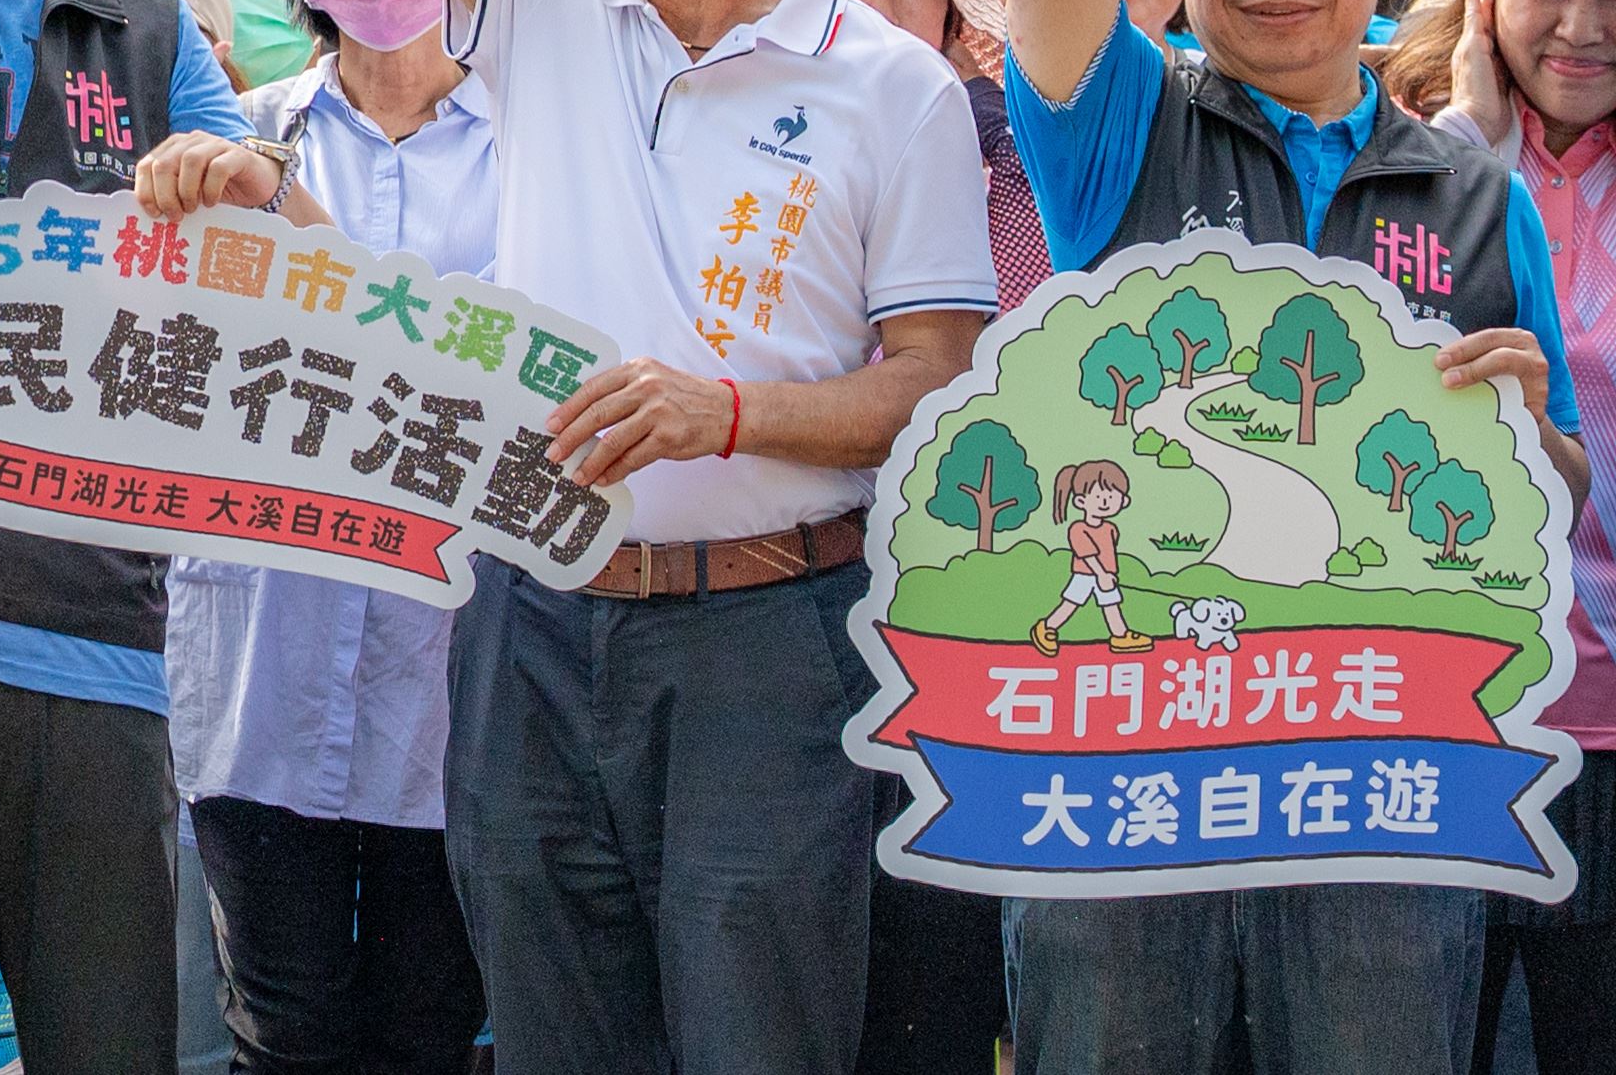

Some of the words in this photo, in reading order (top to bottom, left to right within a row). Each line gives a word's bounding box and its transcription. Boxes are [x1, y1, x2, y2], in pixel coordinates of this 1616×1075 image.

[65, 70, 133, 150] 桃
[748, 135, 759, 149] le
[759, 143, 778, 156] coq
[778, 149, 812, 165] sportif
[751, 172, 818, 336] 桃園市議員
[1374, 217, 1452, 296] 桃
[205, 489, 408, 557] 大溪自在遊
[985, 646, 1405, 738] 石門湖光走
[1021, 757, 1441, 848] 大溪自在遊
